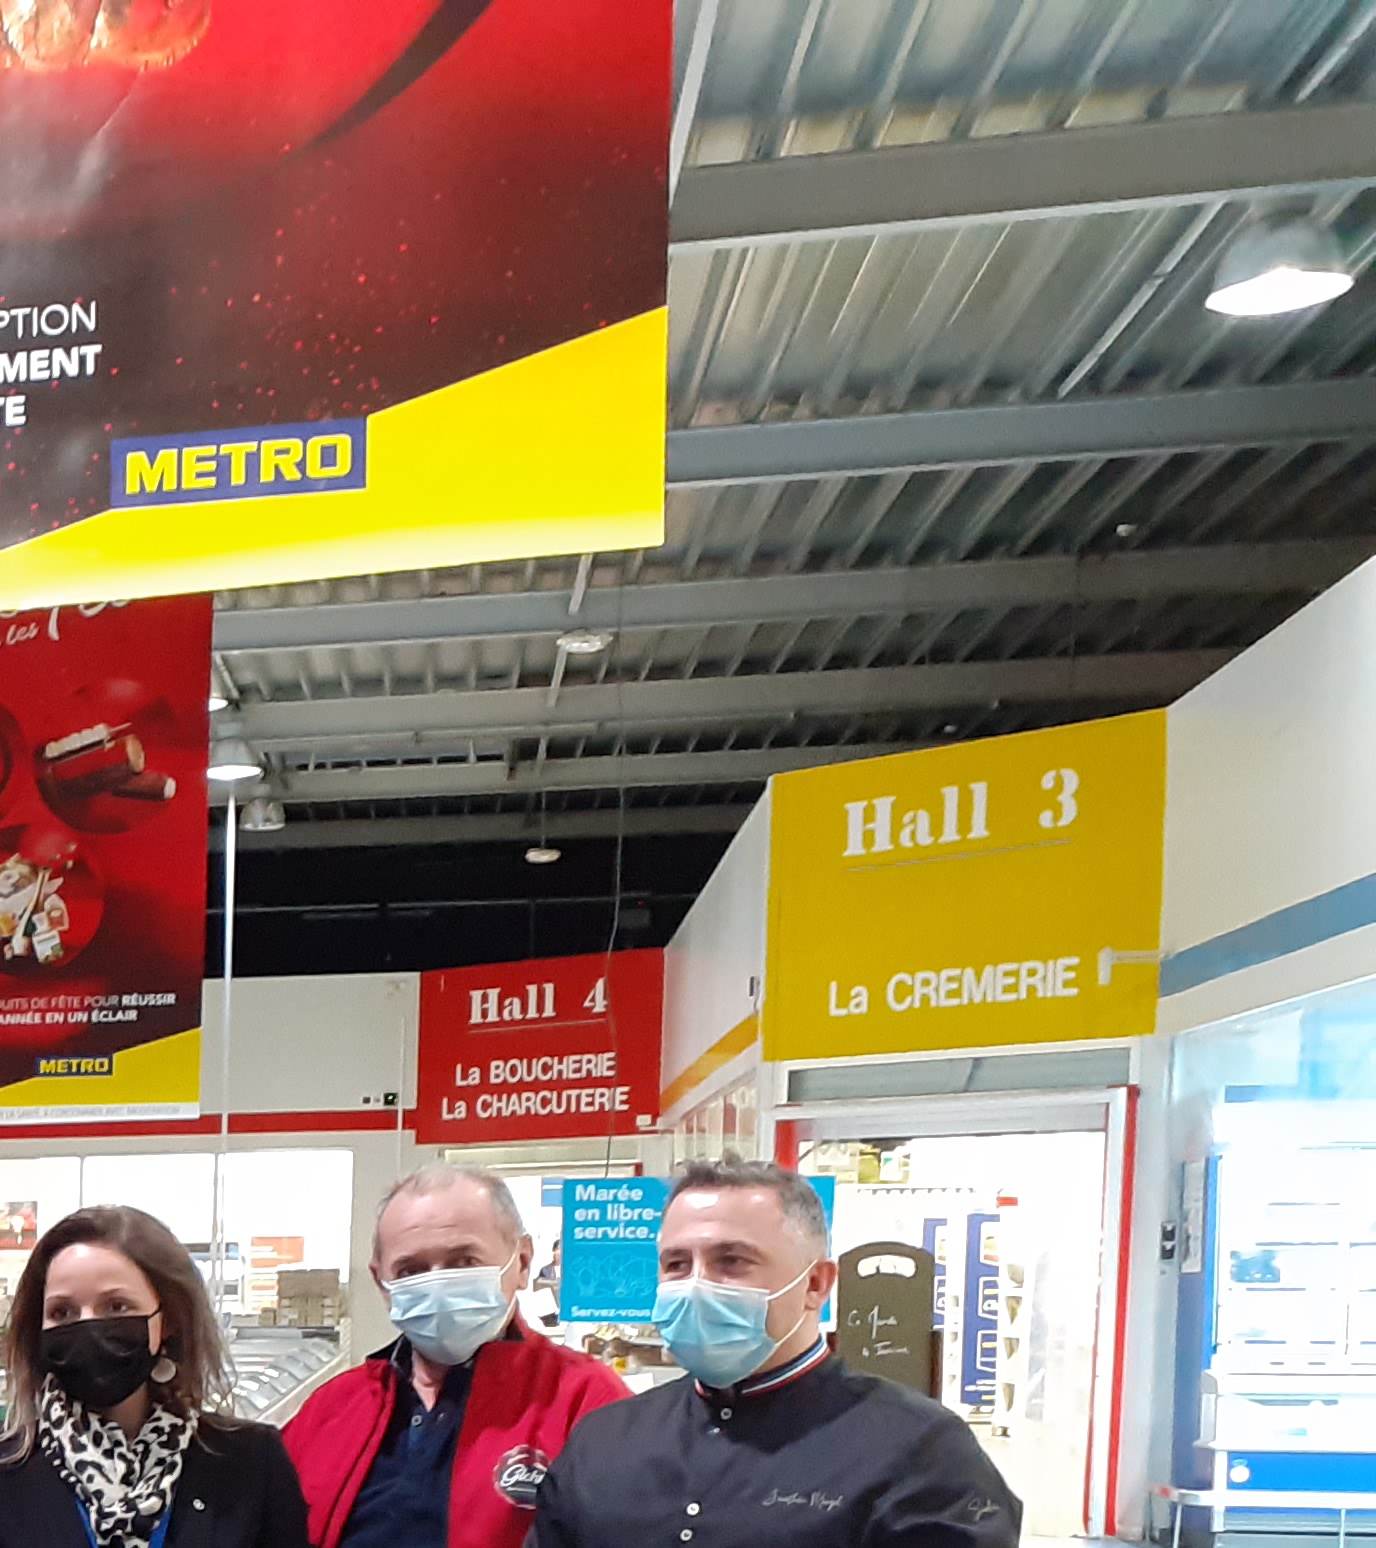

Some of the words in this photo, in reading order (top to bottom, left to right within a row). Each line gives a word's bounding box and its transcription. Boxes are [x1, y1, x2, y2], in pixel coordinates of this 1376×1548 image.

[125, 433, 352, 495] METRO
[5, 622, 39, 646] les
[843, 782, 990, 857] Hall
[1039, 768, 1079, 828] 3
[829, 981, 869, 1017] La
[886, 956, 1080, 1012] CREMERIE
[31, 998, 48, 1009] DE
[51, 995, 81, 1008] FÊTE
[84, 996, 119, 1007] POUR
[122, 993, 176, 1006] RÉUSSIR
[469, 982, 556, 1024] Hall
[583, 977, 609, 1013] 4
[45, 1012, 64, 1024] EN
[67, 1011, 88, 1023] UN
[91, 1009, 138, 1022] ÉCLAIR
[40, 1058, 109, 1074] METRO
[455, 1063, 480, 1086] La
[489, 1052, 616, 1084] BOUCHERIE
[441, 1098, 467, 1120] La
[476, 1086, 631, 1119] CHARCUTERIE
[575, 1184, 643, 1201] Marée
[574, 1207, 602, 1222] en
[606, 1203, 662, 1221] libre-
[573, 1222, 655, 1240] service.
[571, 1306, 651, 1317] Servez-vous
